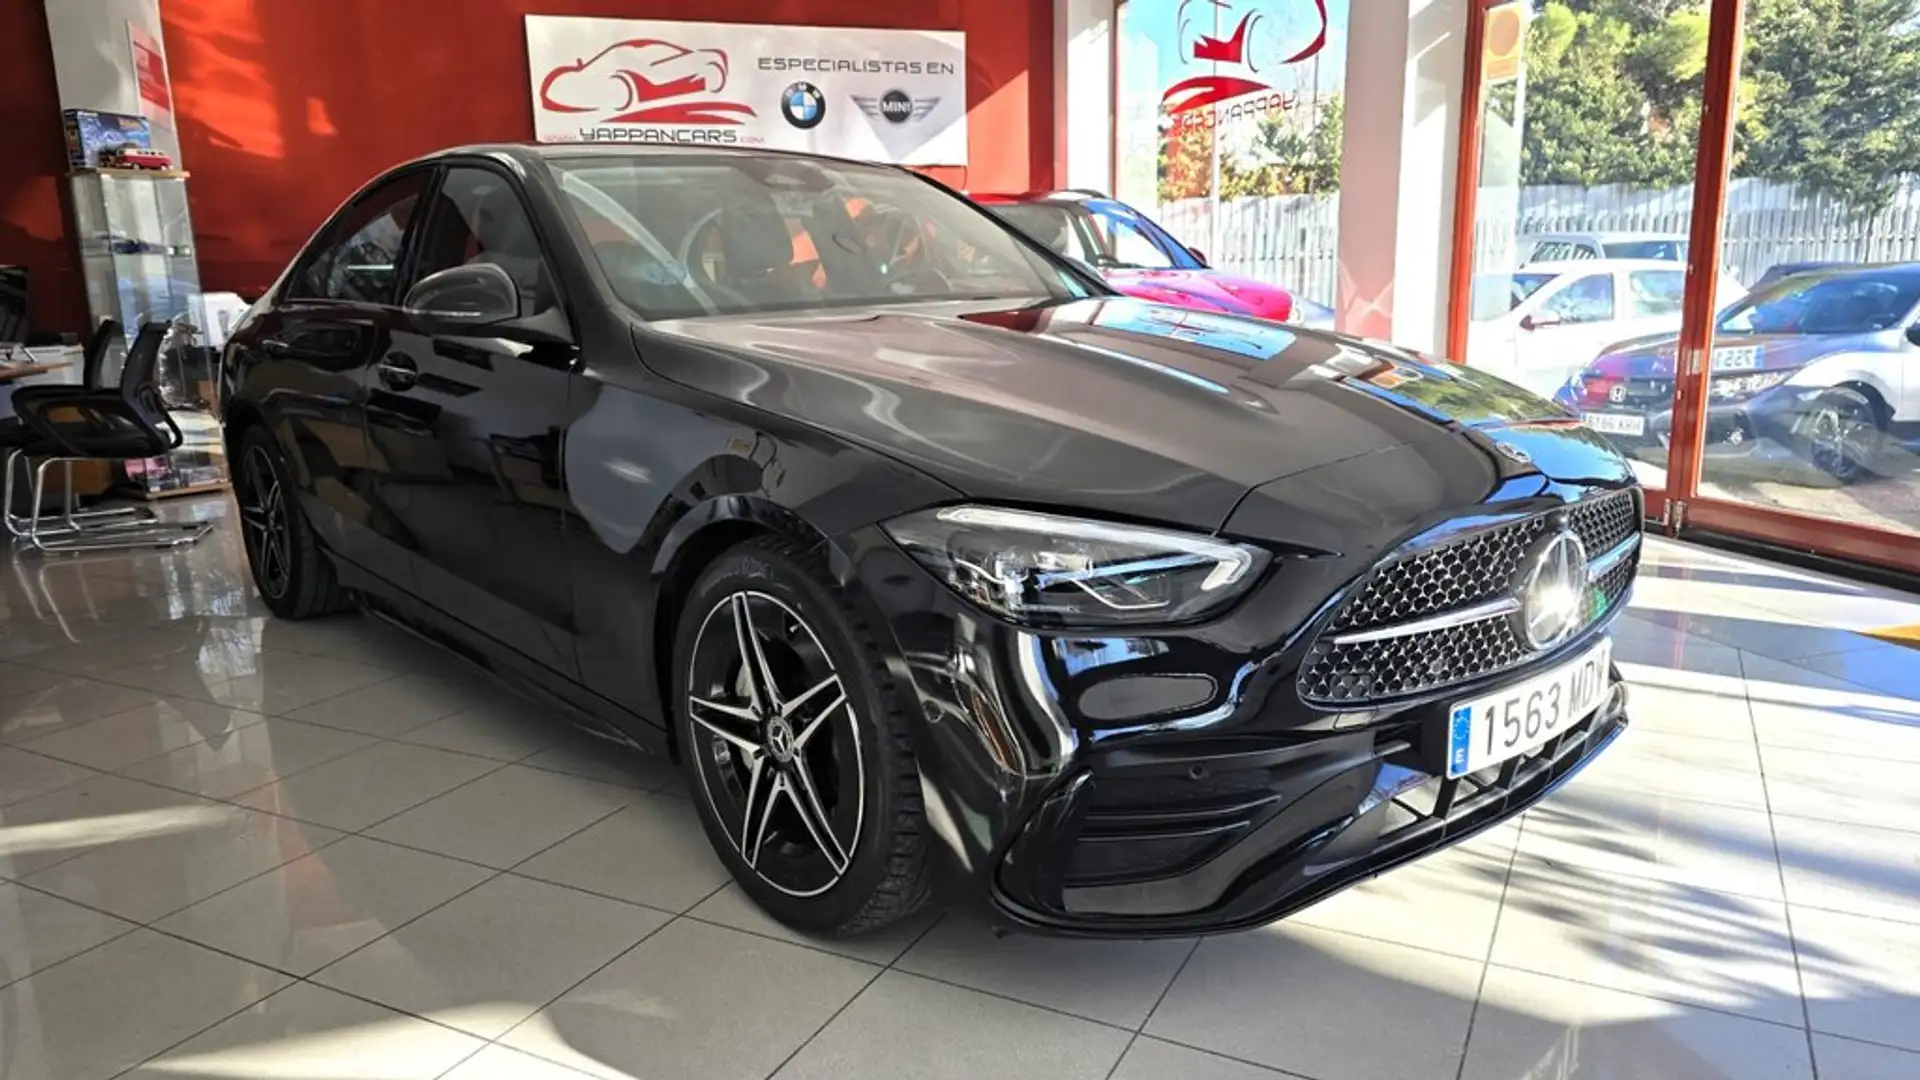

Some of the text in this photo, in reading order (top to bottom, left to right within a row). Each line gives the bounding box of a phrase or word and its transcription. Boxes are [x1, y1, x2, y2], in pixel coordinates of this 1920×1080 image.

[758, 57, 954, 75] ESPECIALISTAS EN
[882, 100, 911, 113] MINI
[580, 127, 737, 143] YAPPANCARS
[1485, 681, 1562, 756] 1563
[1455, 748, 1465, 764] E
